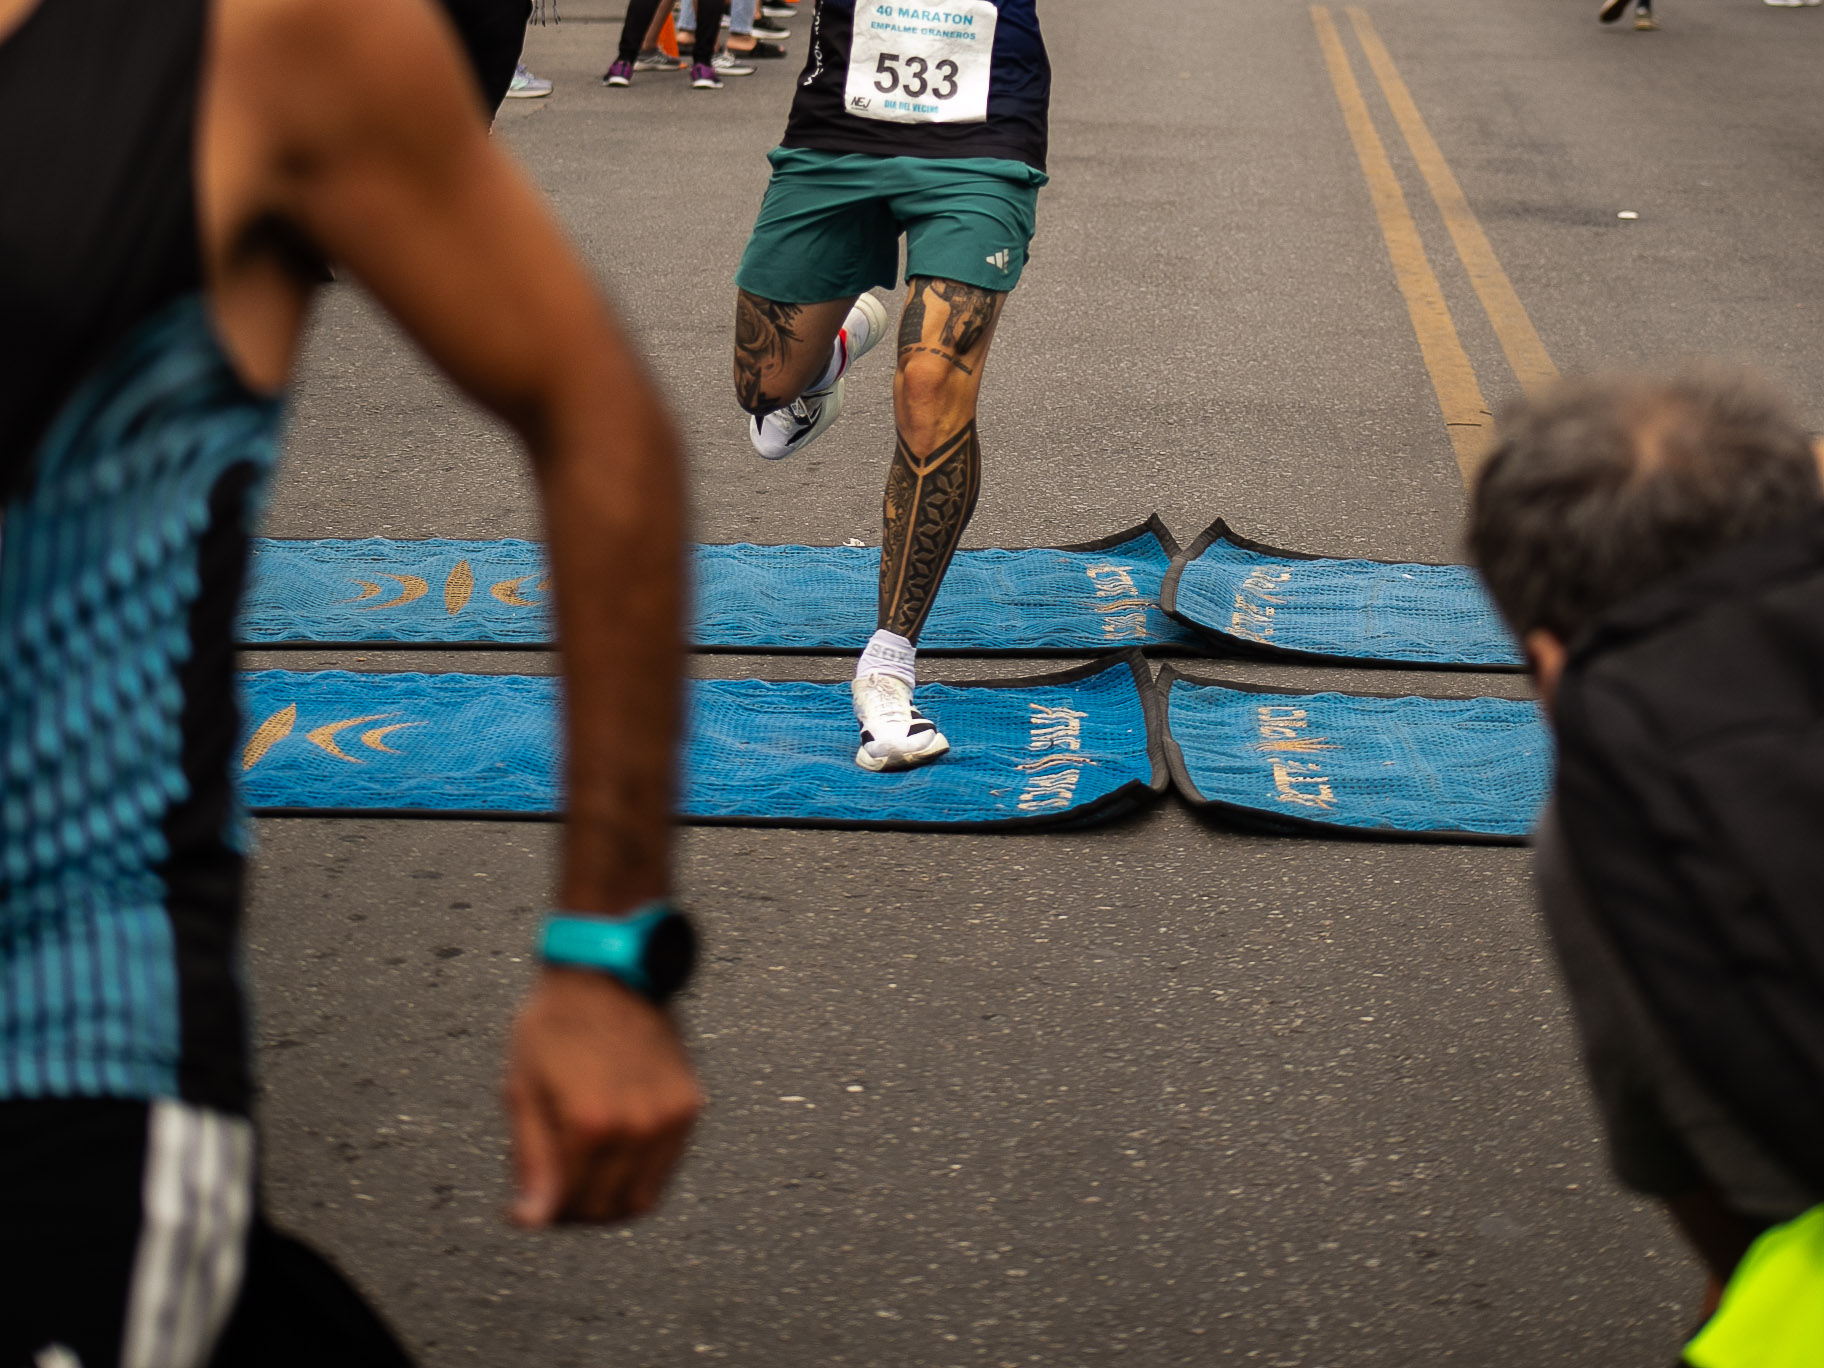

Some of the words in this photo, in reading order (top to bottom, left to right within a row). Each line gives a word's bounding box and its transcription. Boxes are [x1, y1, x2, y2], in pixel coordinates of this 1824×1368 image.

[898, 7, 974, 25] MARATON
[871, 21, 917, 34] EMPALME
[920, 27, 976, 40] GRANEROS
[874, 52, 959, 100] 533
